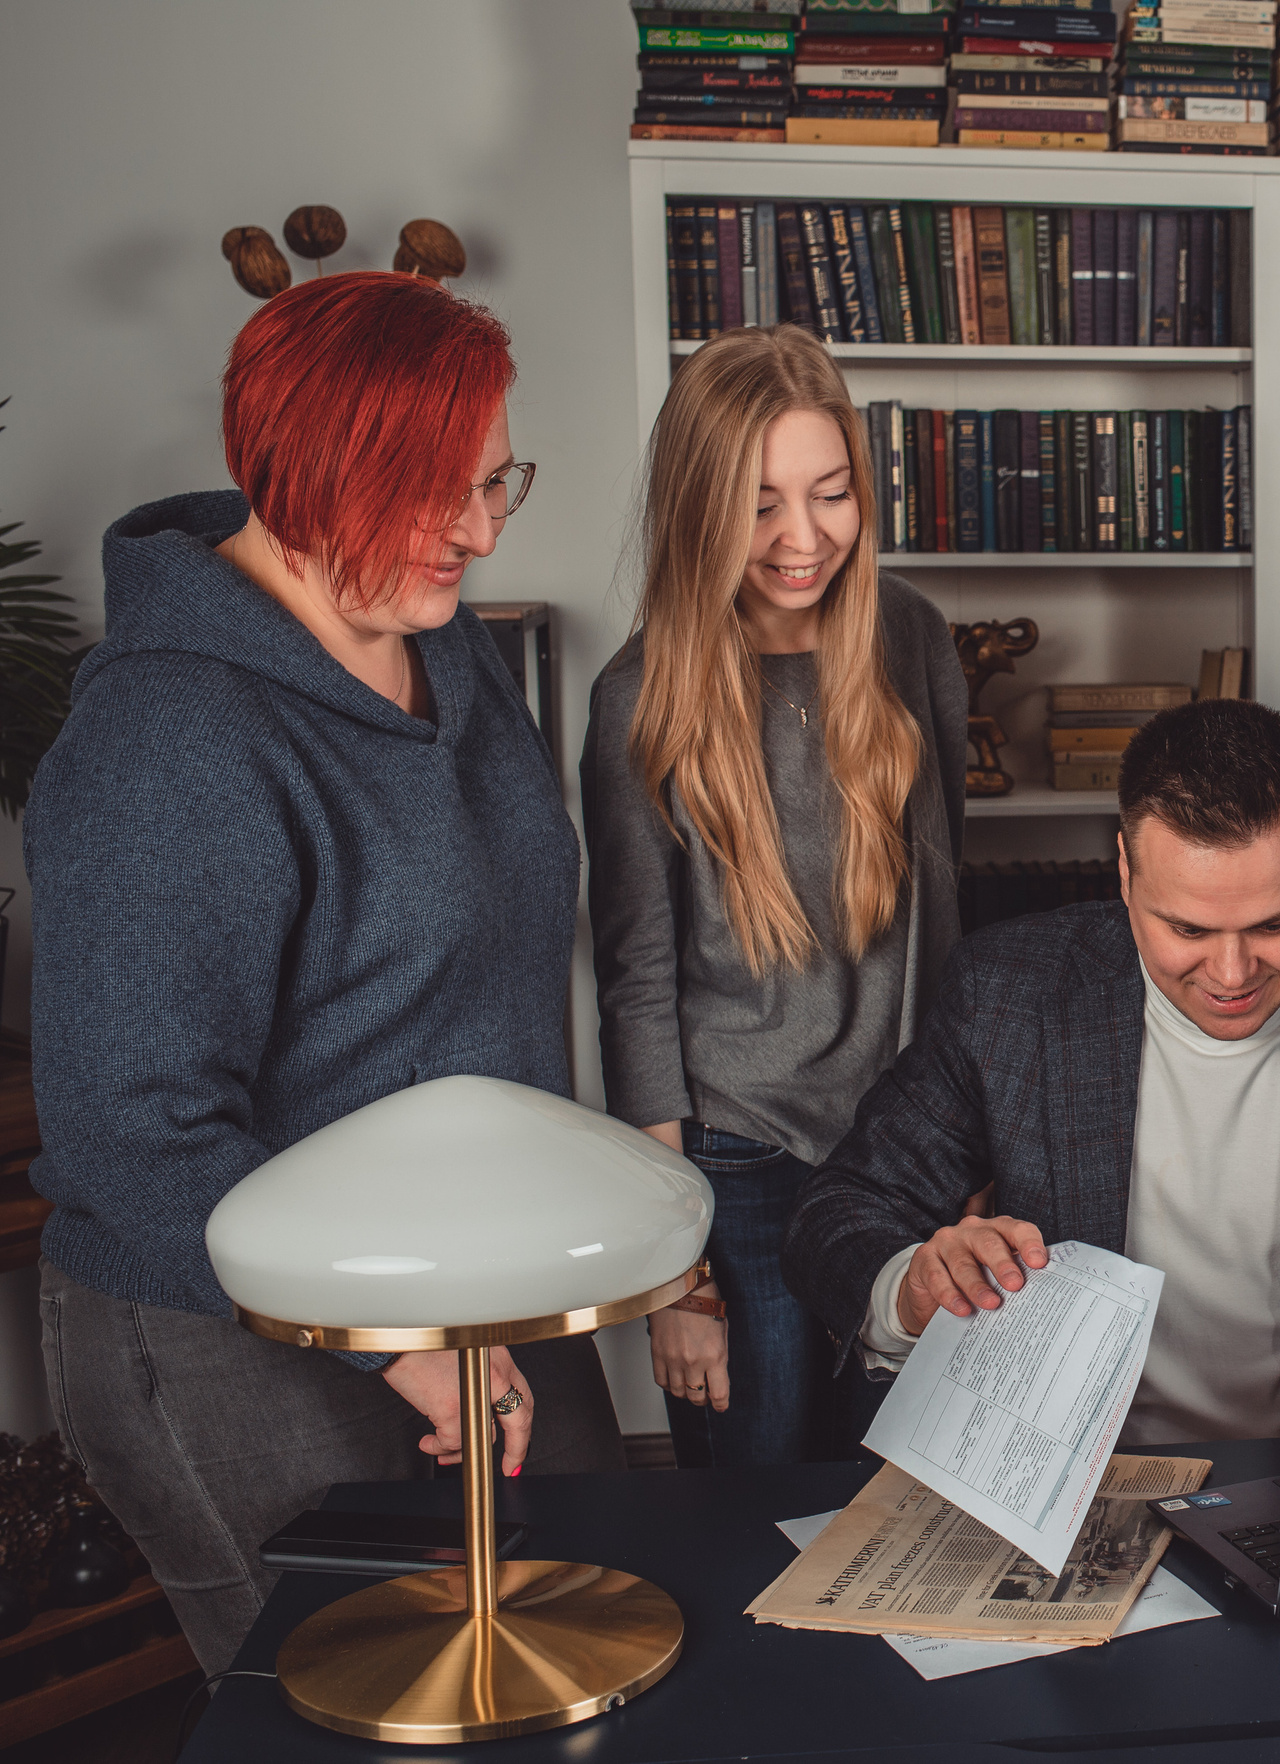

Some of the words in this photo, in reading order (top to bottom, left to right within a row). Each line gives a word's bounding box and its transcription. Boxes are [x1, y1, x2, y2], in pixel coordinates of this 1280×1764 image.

[824, 1538, 886, 1597] KATHIMERINI
[858, 1591, 886, 1610] VAT
[877, 1570, 903, 1591] plan
[891, 1541, 926, 1570] freezes
[974, 1590, 988, 1600] Time
[985, 1574, 998, 1585] Greek
